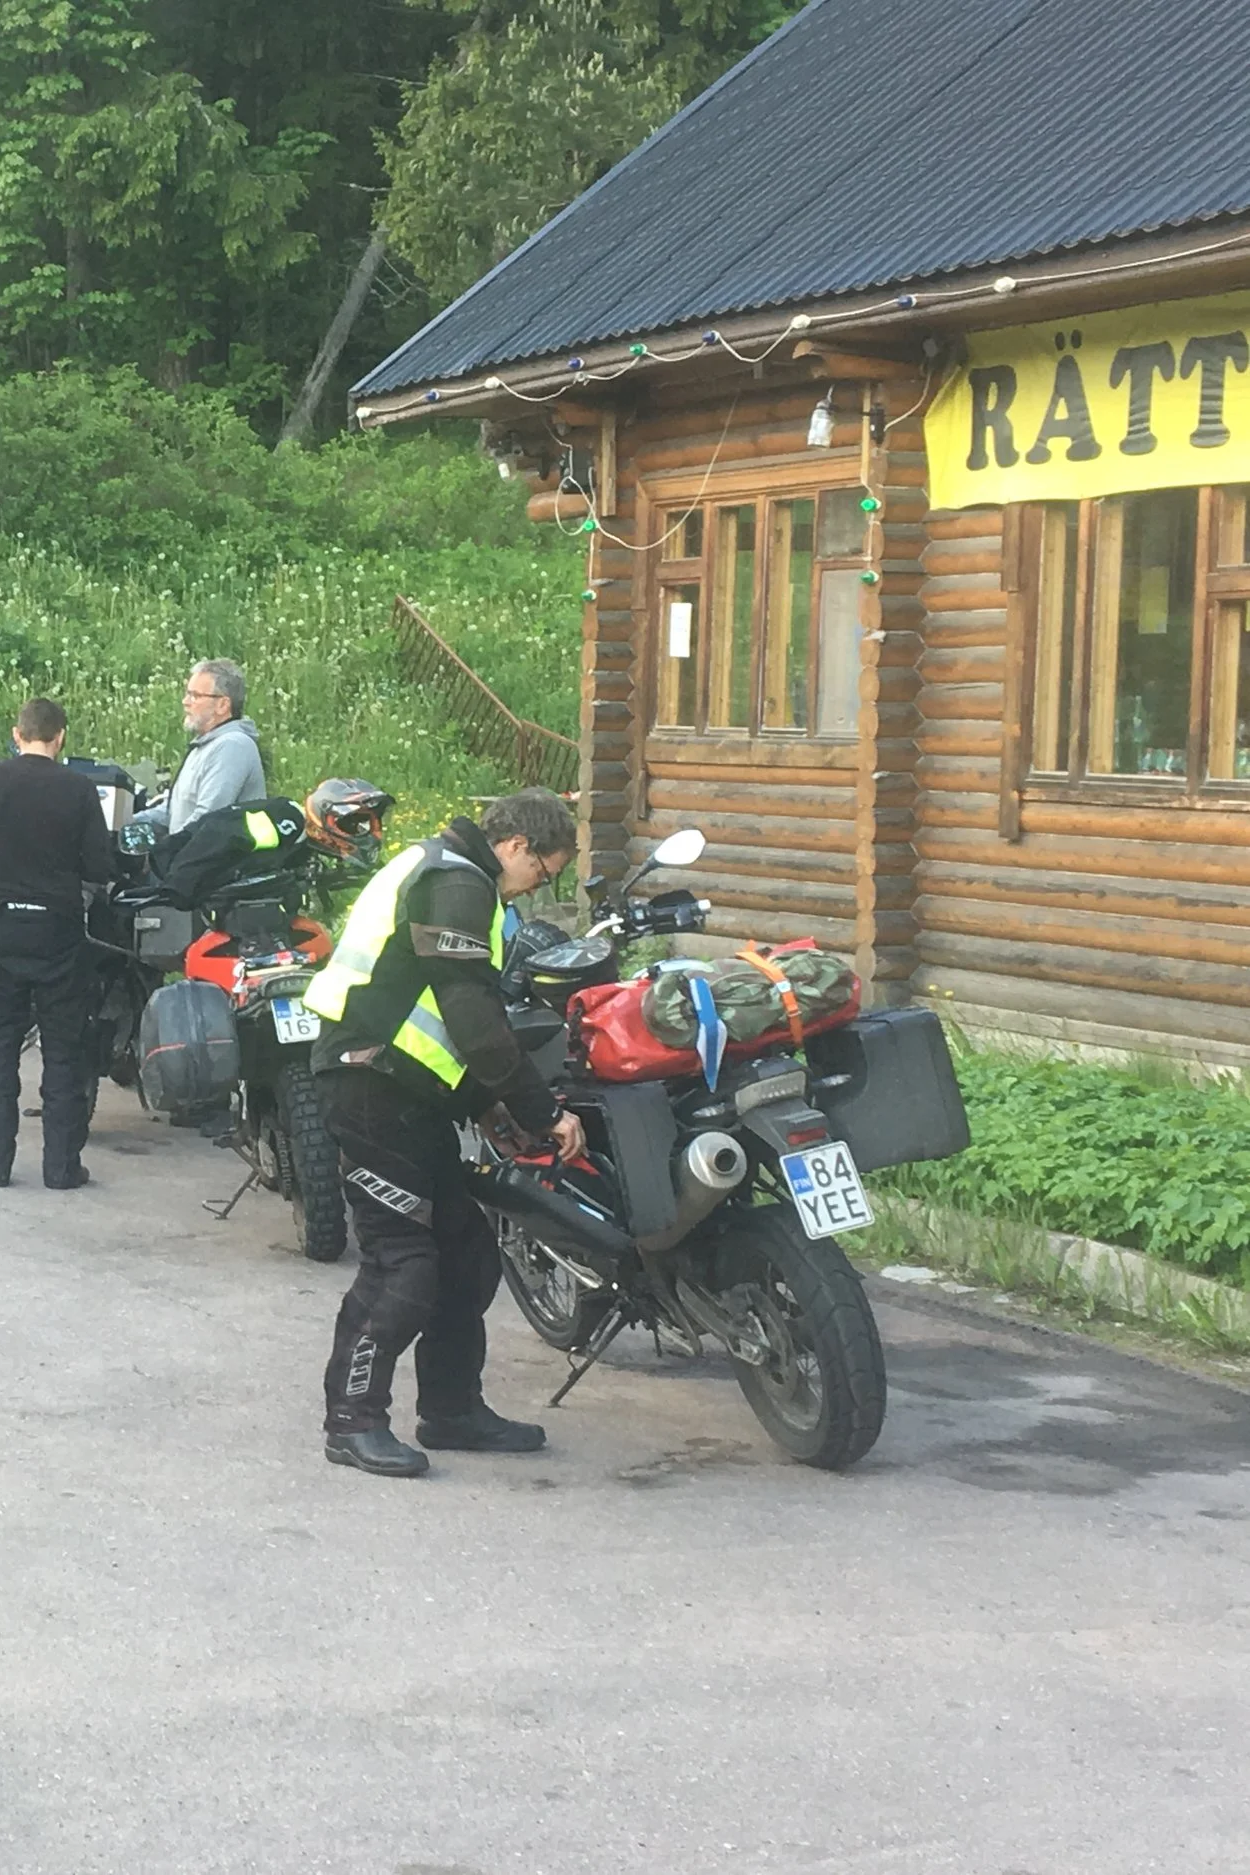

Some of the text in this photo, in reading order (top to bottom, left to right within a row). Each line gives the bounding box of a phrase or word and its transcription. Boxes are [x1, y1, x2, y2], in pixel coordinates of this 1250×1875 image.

[966, 329, 1250, 471] RÄTT
[810, 1151, 852, 1188] 84
[801, 1186, 866, 1228] YEE
